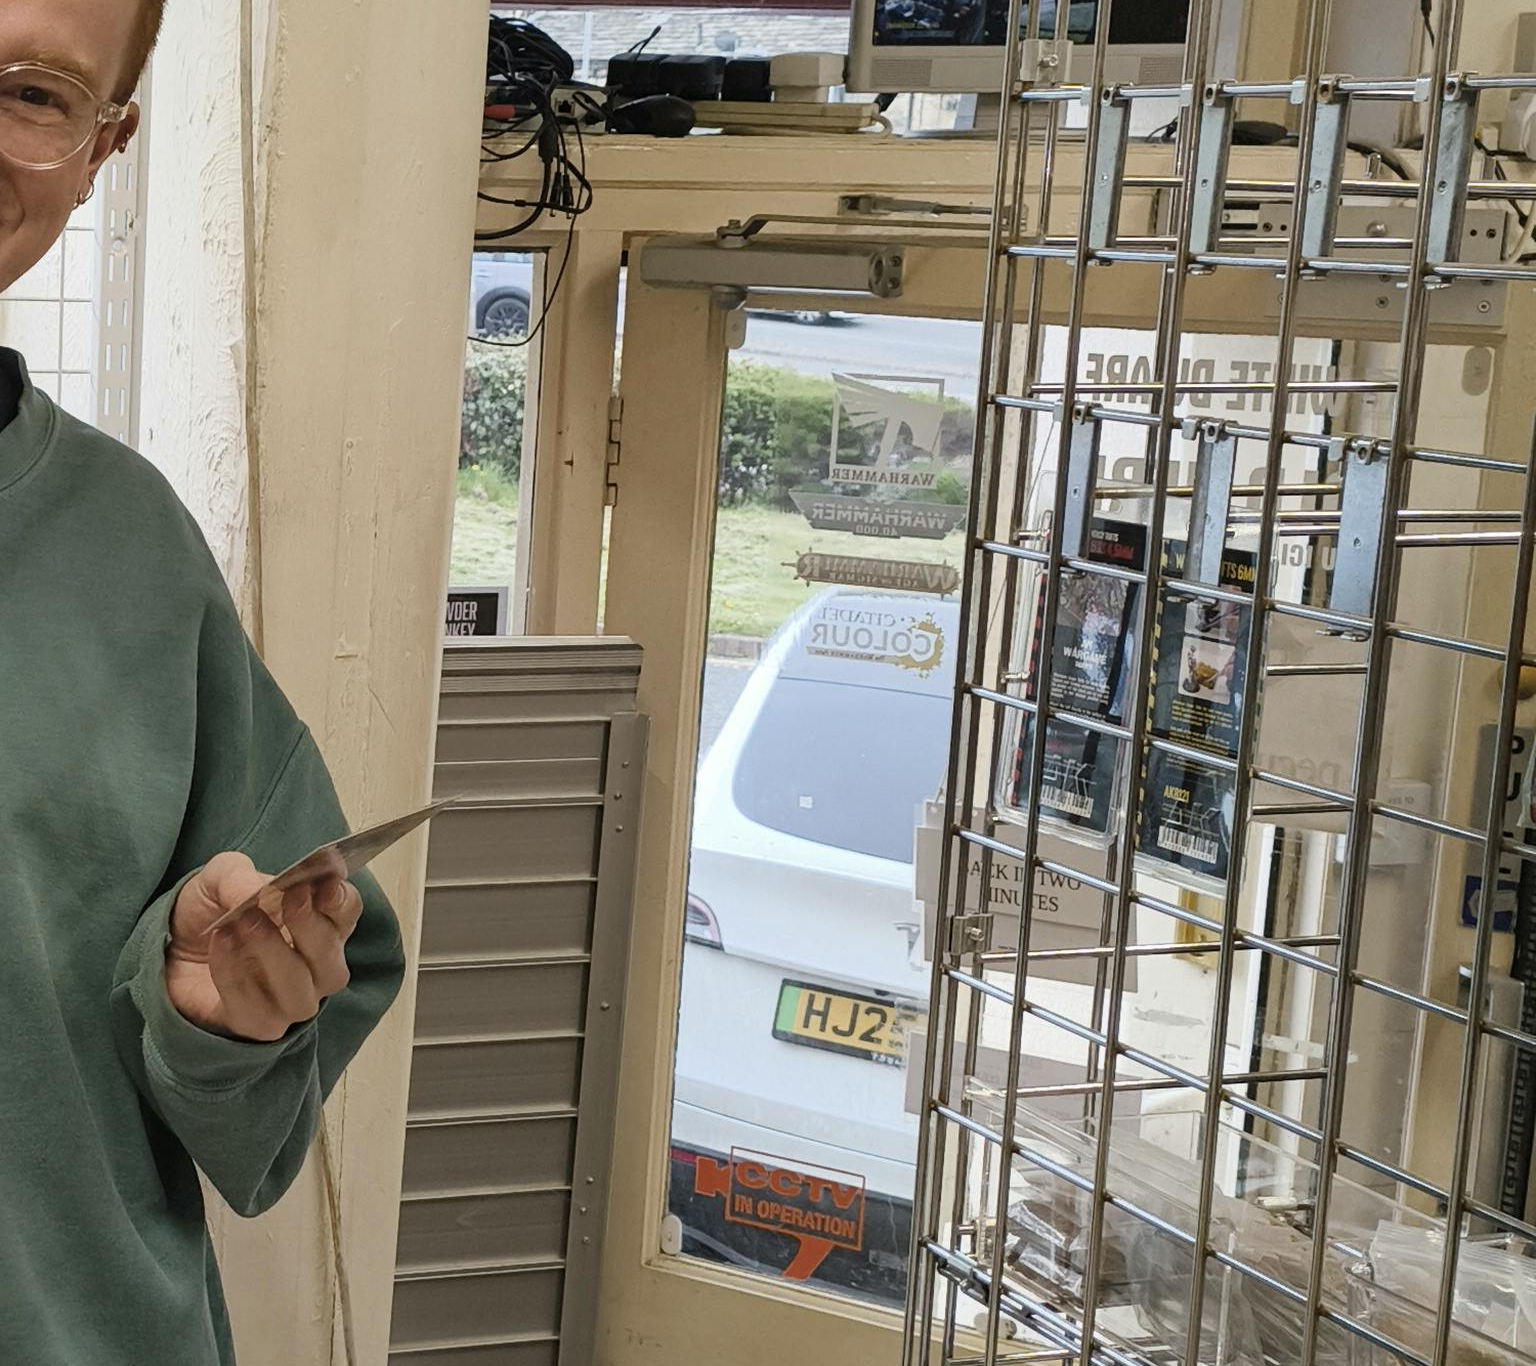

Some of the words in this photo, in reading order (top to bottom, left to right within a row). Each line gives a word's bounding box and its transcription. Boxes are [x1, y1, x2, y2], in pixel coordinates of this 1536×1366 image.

[1037, 868, 1082, 891] TWO
[734, 1161, 860, 1209] CCTV
[734, 1195, 752, 1215] IN
[756, 1201, 856, 1240] OPERATION
